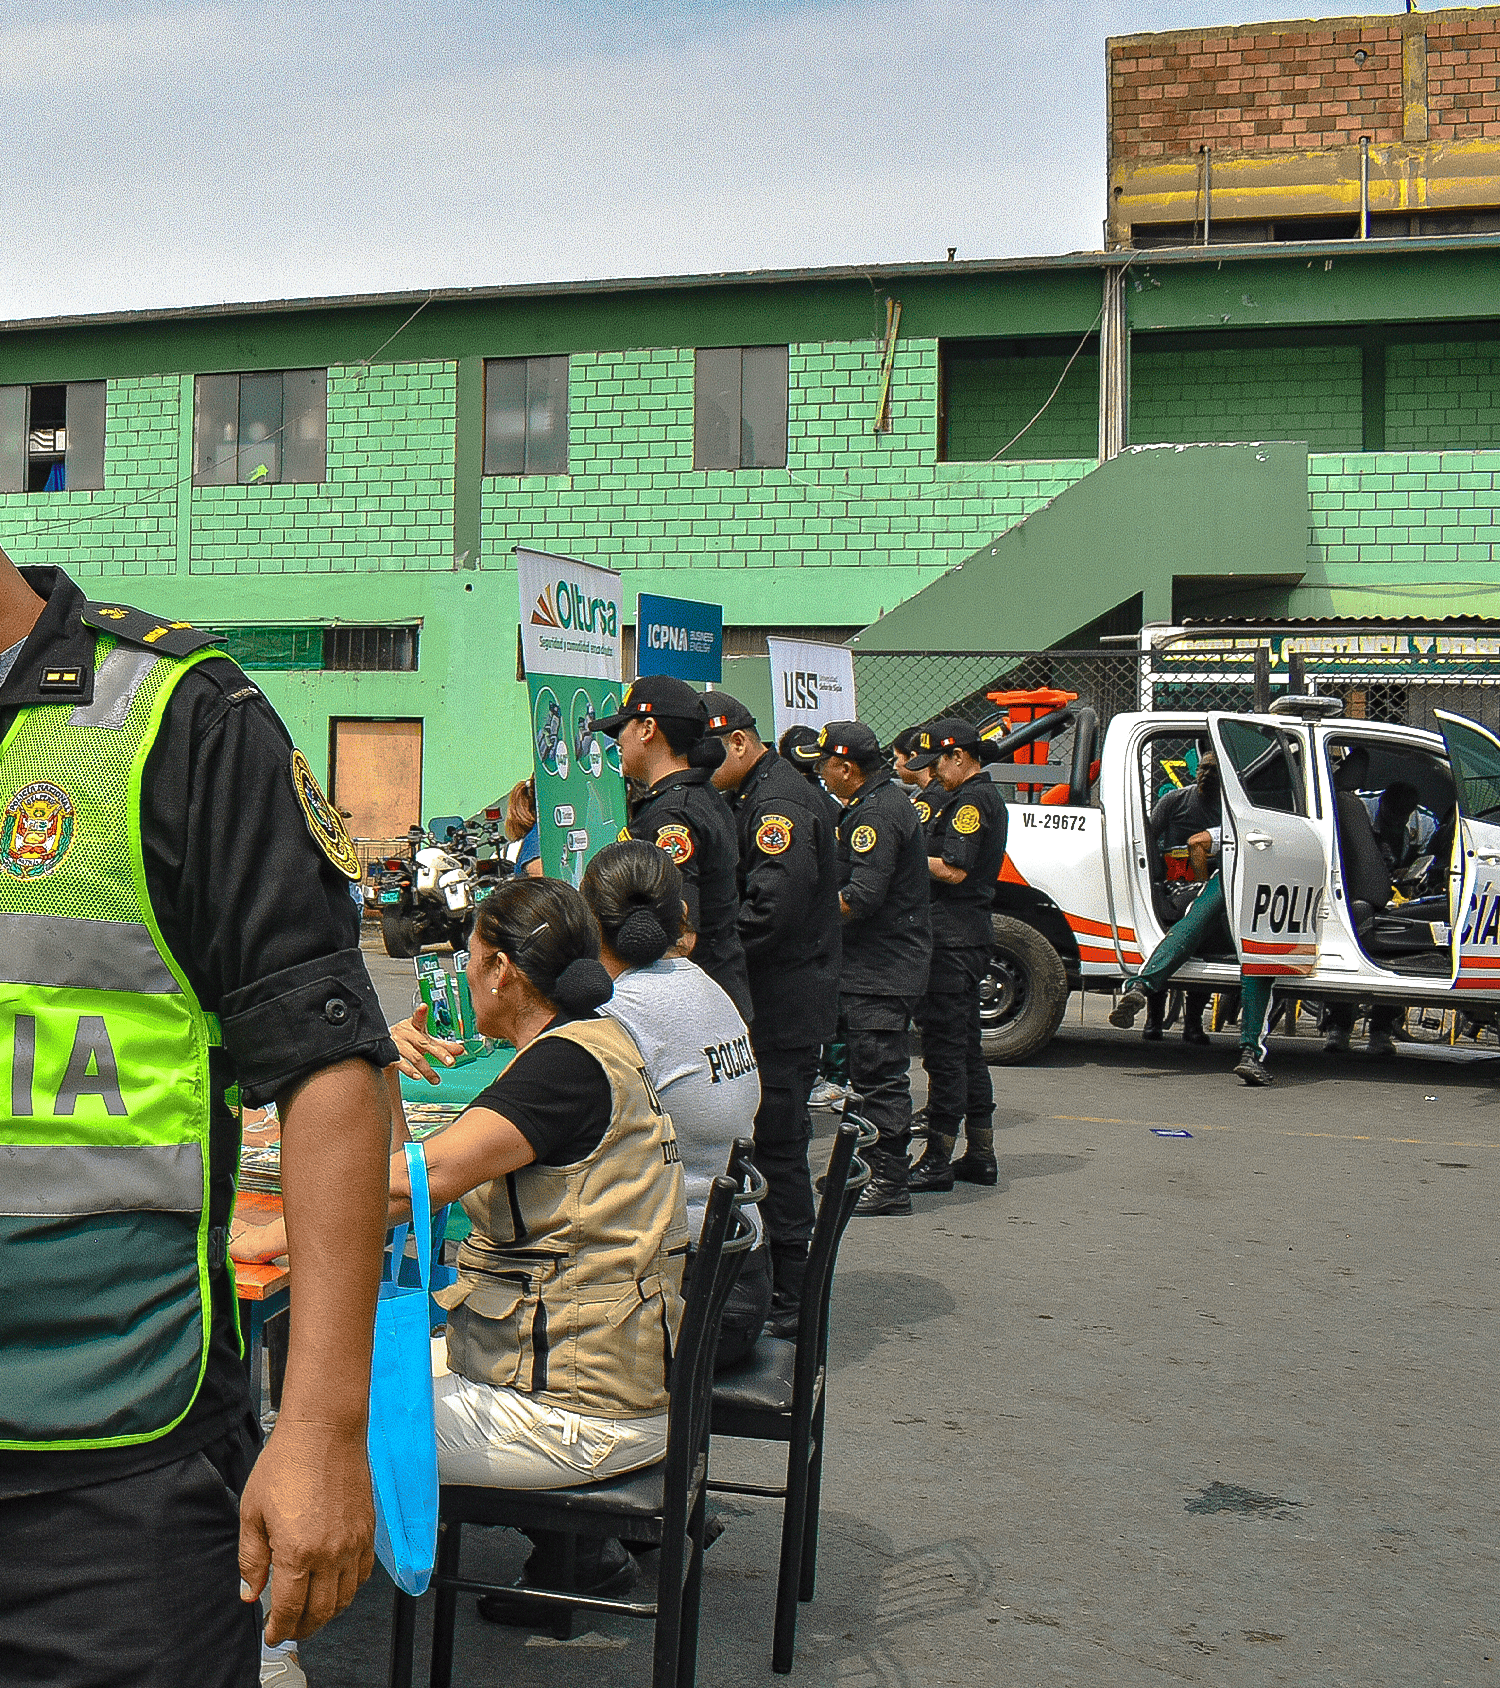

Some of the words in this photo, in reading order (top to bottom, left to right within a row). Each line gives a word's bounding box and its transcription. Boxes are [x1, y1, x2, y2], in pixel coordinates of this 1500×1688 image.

[556, 580, 617, 638] Oltursa
[647, 623, 688, 652] ICPNA
[783, 671, 819, 710] USS
[1022, 812, 1087, 832] VL-29672
